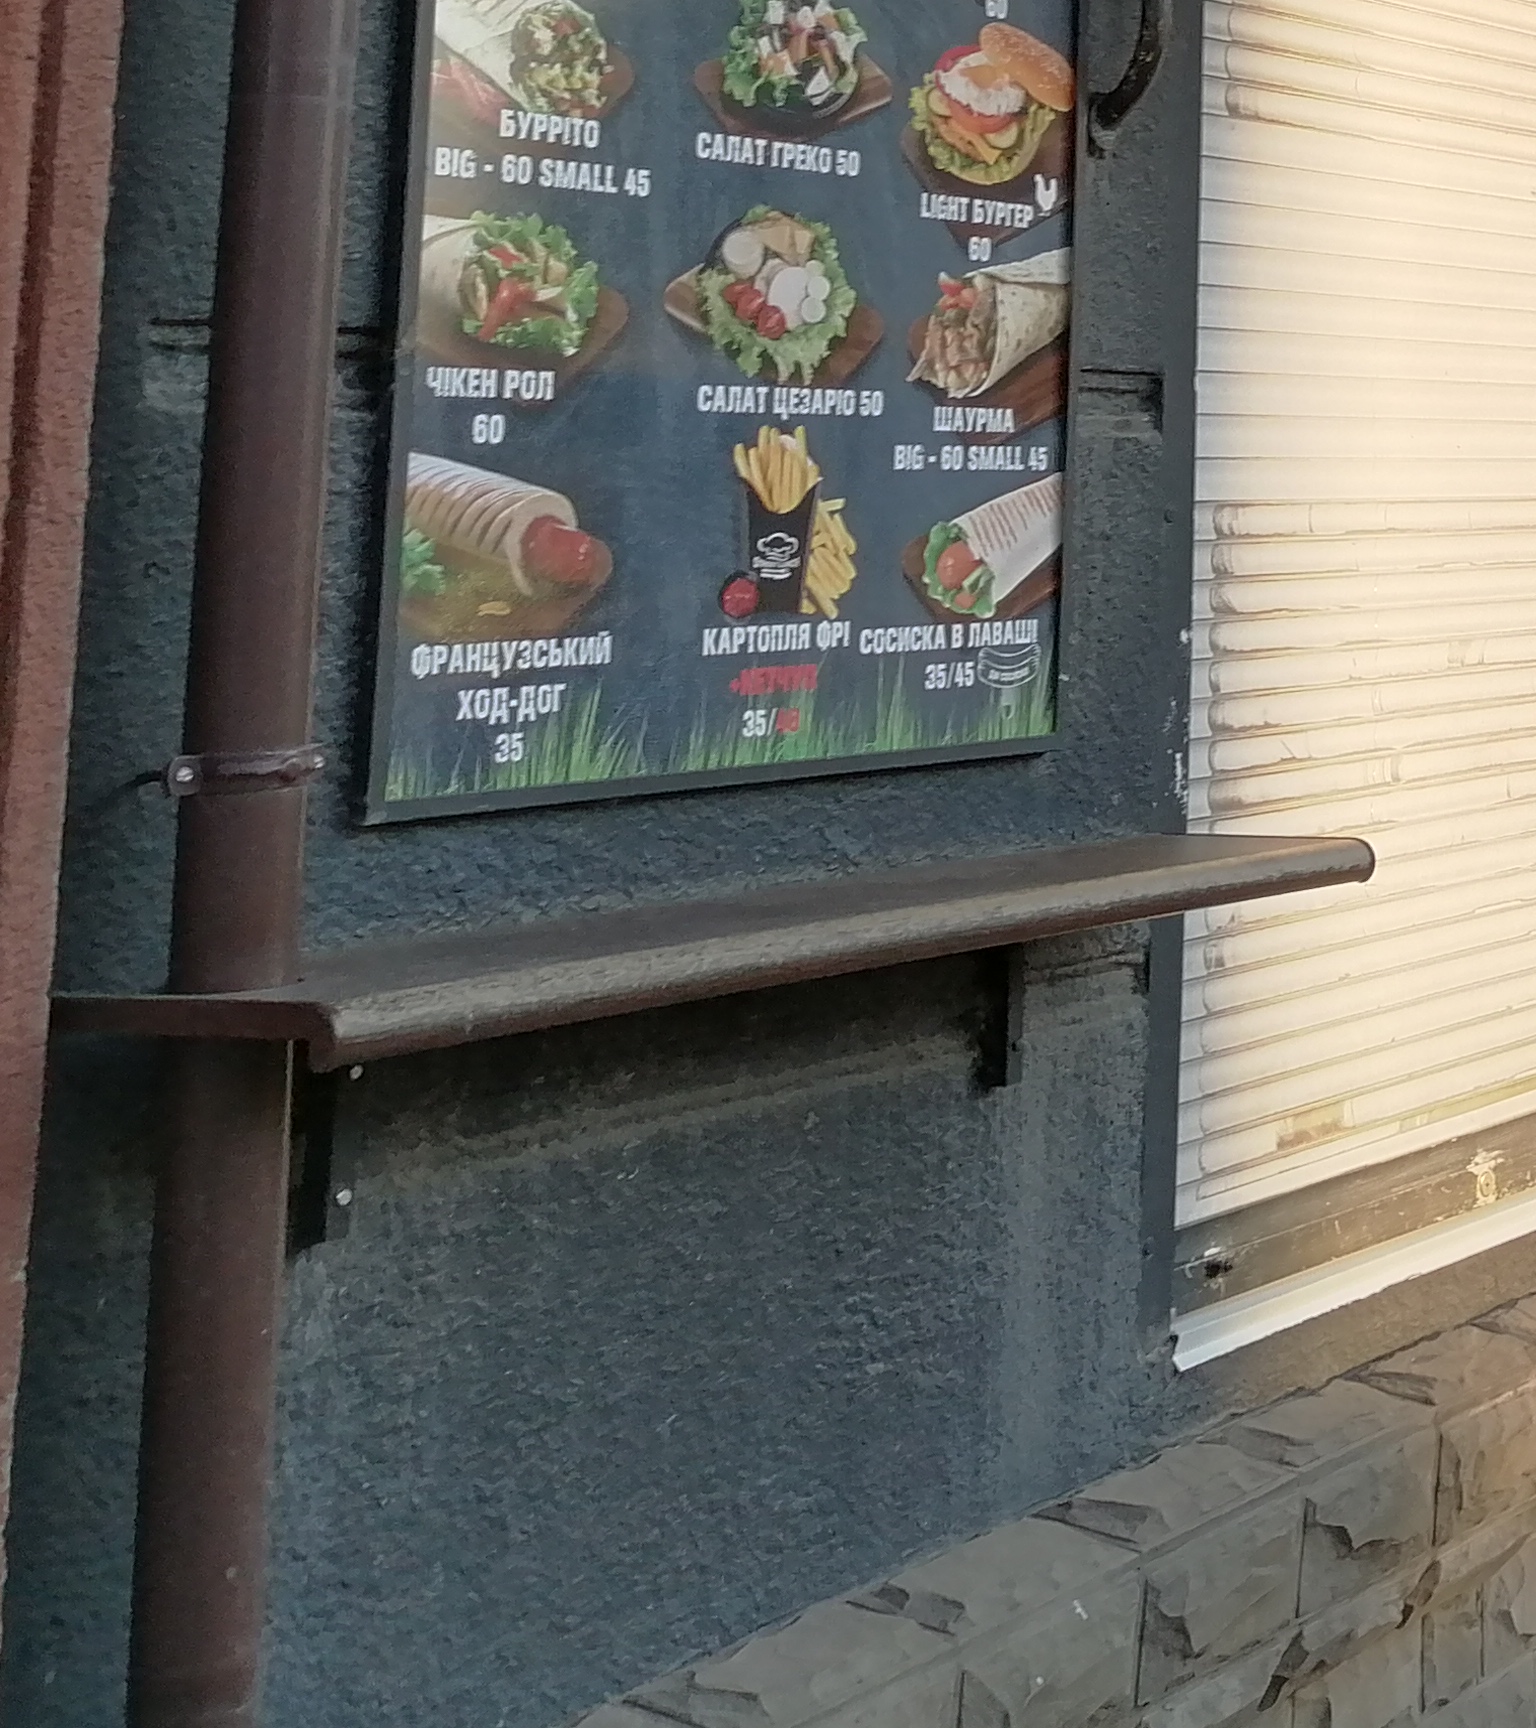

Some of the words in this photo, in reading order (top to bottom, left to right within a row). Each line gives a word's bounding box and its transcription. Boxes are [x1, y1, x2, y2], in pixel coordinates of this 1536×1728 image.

[499, 108, 602, 150] БУРРІТО
[695, 132, 770, 166] САЛАТ
[771, 140, 834, 175] ГРЕКО
[835, 149, 862, 177] 50
[434, 146, 478, 180] BIG
[499, 154, 534, 184] 60
[537, 157, 620, 195] SMALL
[622, 168, 653, 198] 45
[971, 198, 1035, 231] БУРГЕР
[424, 365, 498, 400] ЧІКЕН
[502, 369, 558, 402] РОЛ
[696, 384, 771, 416] САЛАТ
[858, 389, 886, 418] 50
[471, 413, 507, 445] 60
[932, 406, 1016, 434] ШАУРМА
[893, 444, 927, 472] BIG
[939, 444, 966, 472] 60
[966, 444, 1026, 472] SMALL
[1027, 445, 1049, 472] 45
[410, 630, 614, 679] ФРАНЦУЗСЬКИЙ
[701, 622, 812, 658] КАРТОПЛЯ
[859, 624, 947, 656] СОСИСКА
[950, 623, 966, 651] В
[923, 660, 976, 691] 35/45
[455, 683, 568, 726] ХОД-ДОГ
[494, 731, 527, 764] 35
